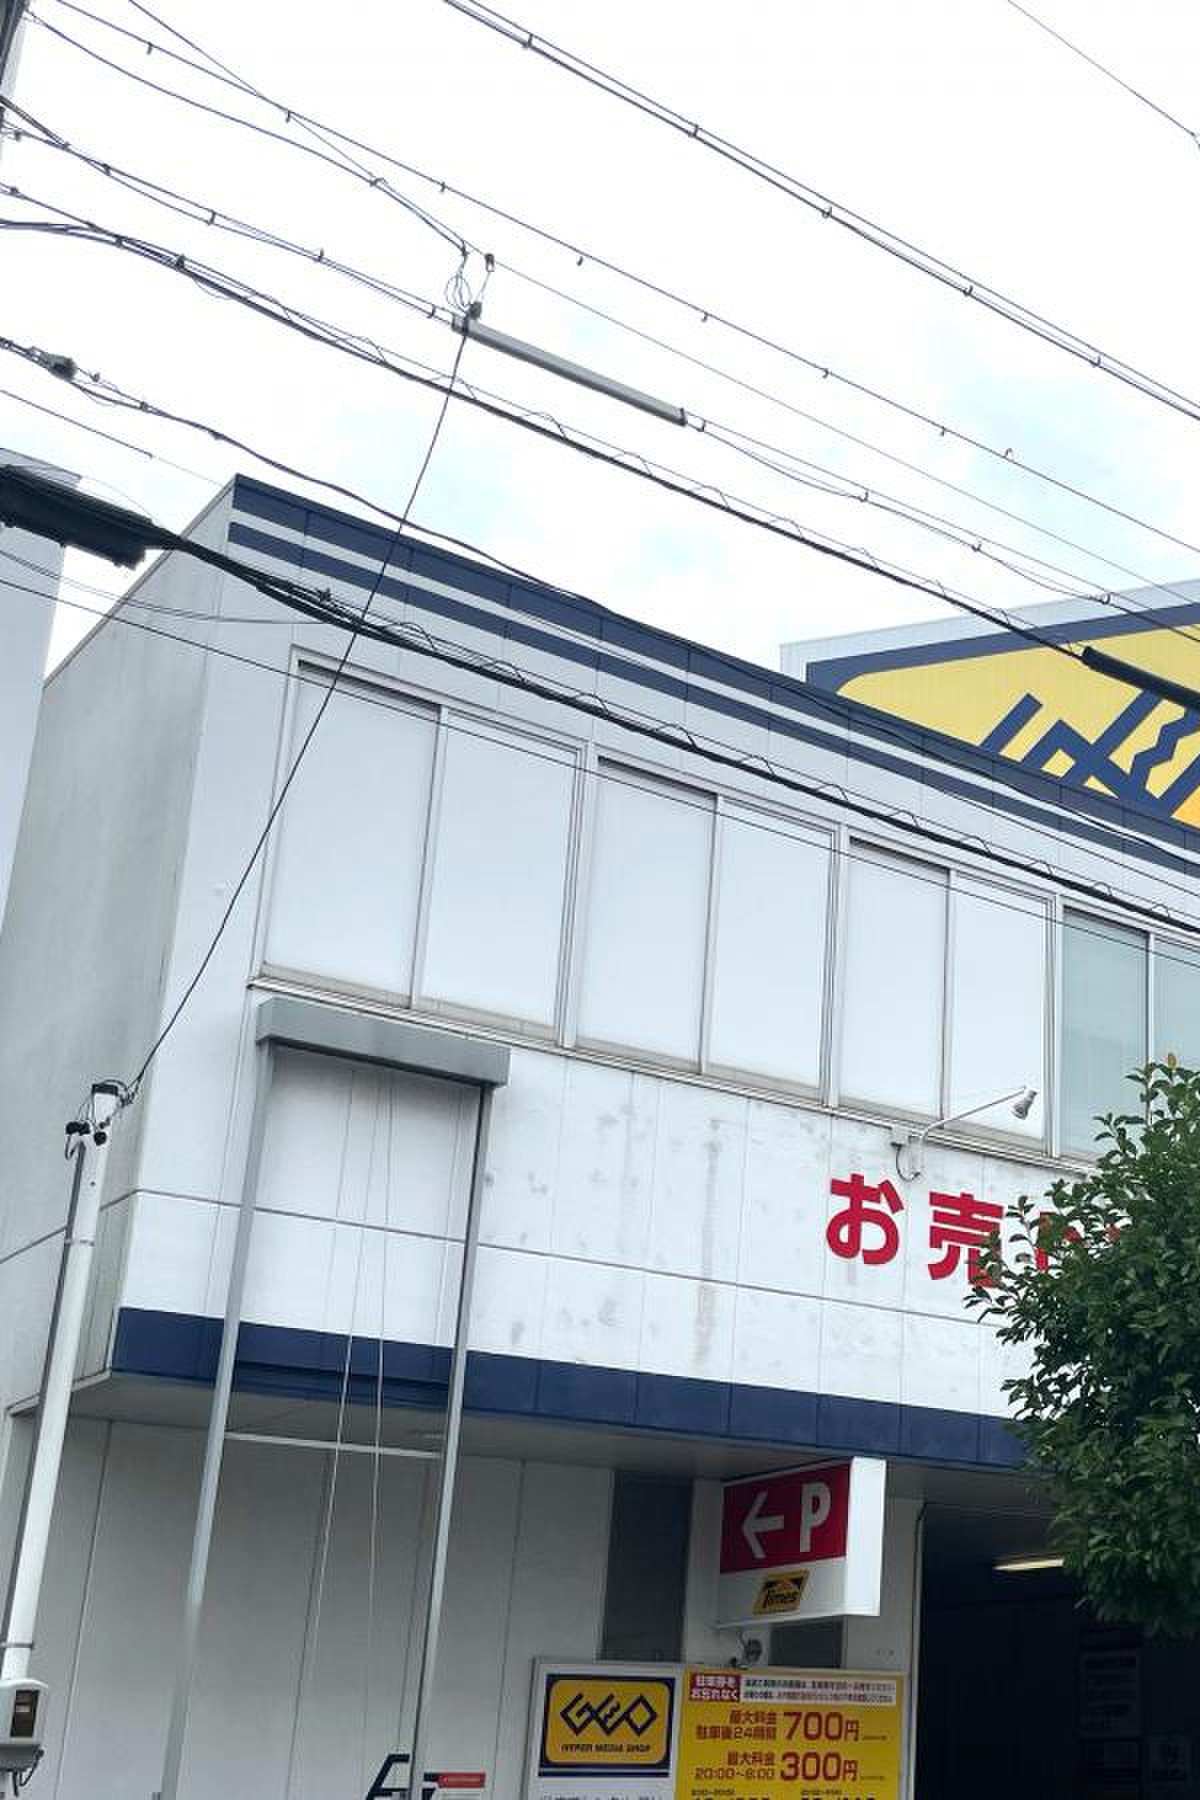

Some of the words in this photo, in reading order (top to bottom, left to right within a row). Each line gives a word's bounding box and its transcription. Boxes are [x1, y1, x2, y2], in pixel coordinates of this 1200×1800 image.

[800, 1482, 832, 1553] P
[560, 1693, 657, 1736] GEO
[783, 1711, 860, 1742] 700円
[780, 1751, 858, 1782] 300円
